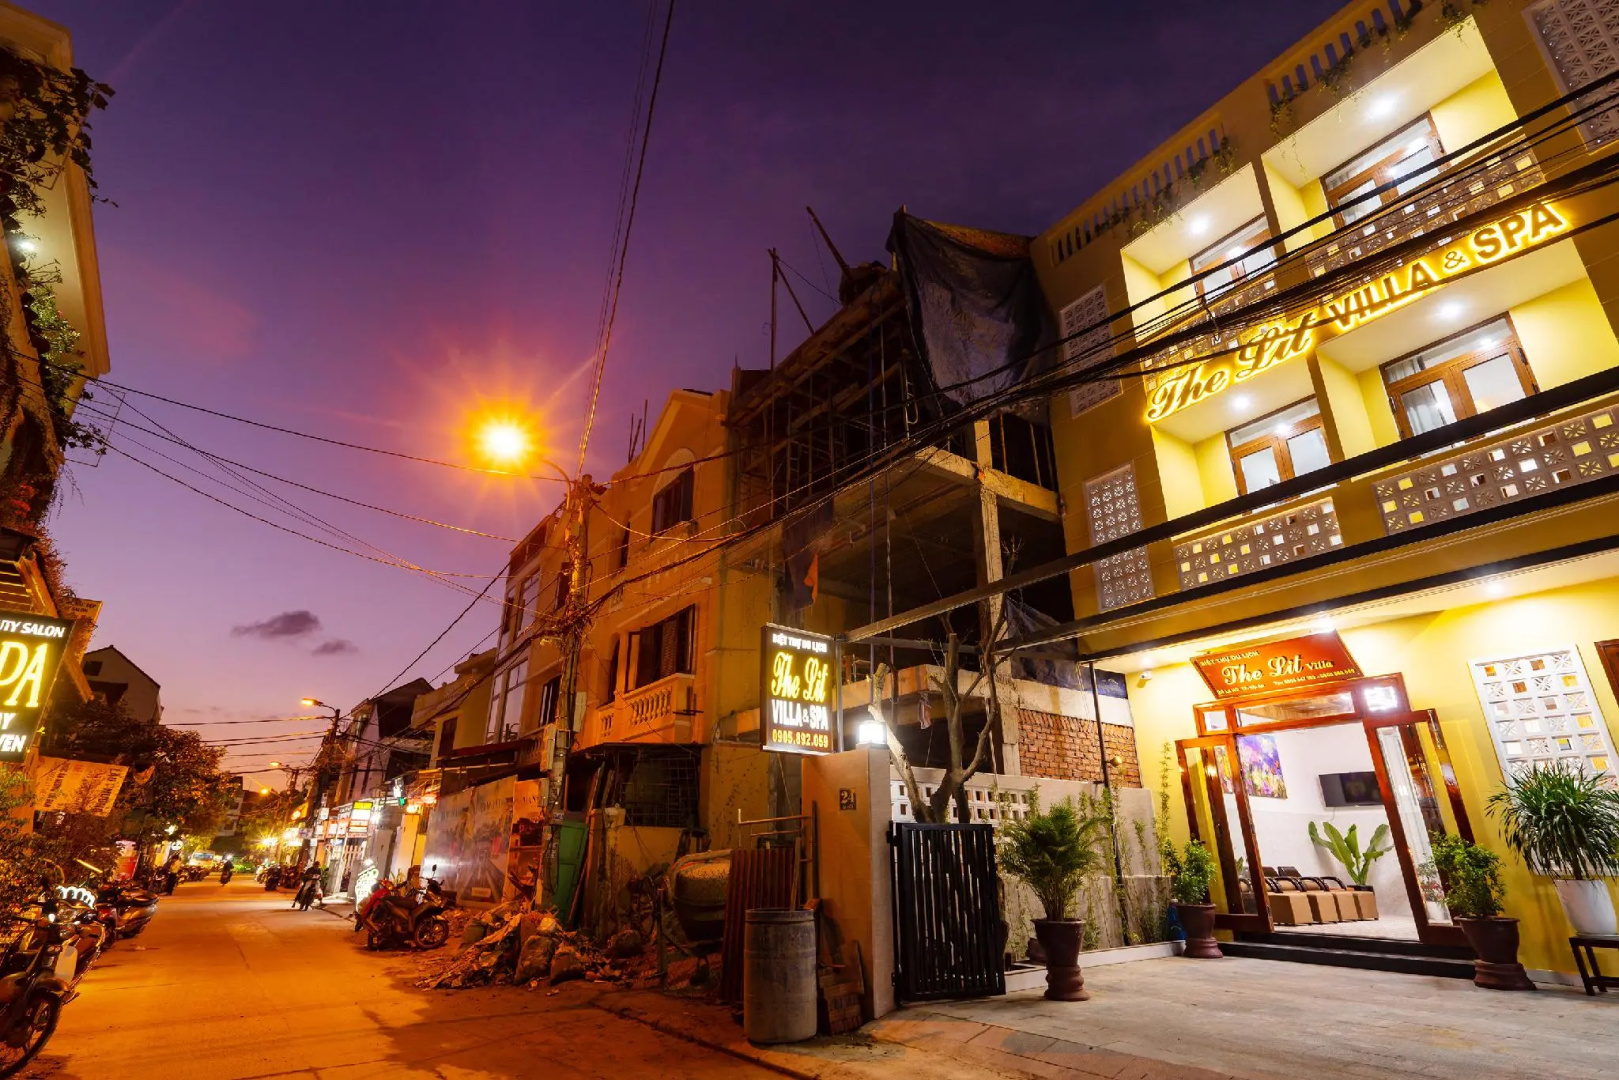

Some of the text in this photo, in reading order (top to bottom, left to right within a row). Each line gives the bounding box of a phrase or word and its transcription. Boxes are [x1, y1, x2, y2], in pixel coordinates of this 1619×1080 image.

[1147, 202, 1565, 420] The Lit VILLA & SPA
[20, 622, 66, 638] SALON
[771, 651, 829, 703] The Lit
[1221, 663, 1263, 685] The
[1267, 654, 1304, 677] Lit
[771, 699, 829, 731] VILLA & SPA
[772, 728, 829, 749] 0905.892.059
